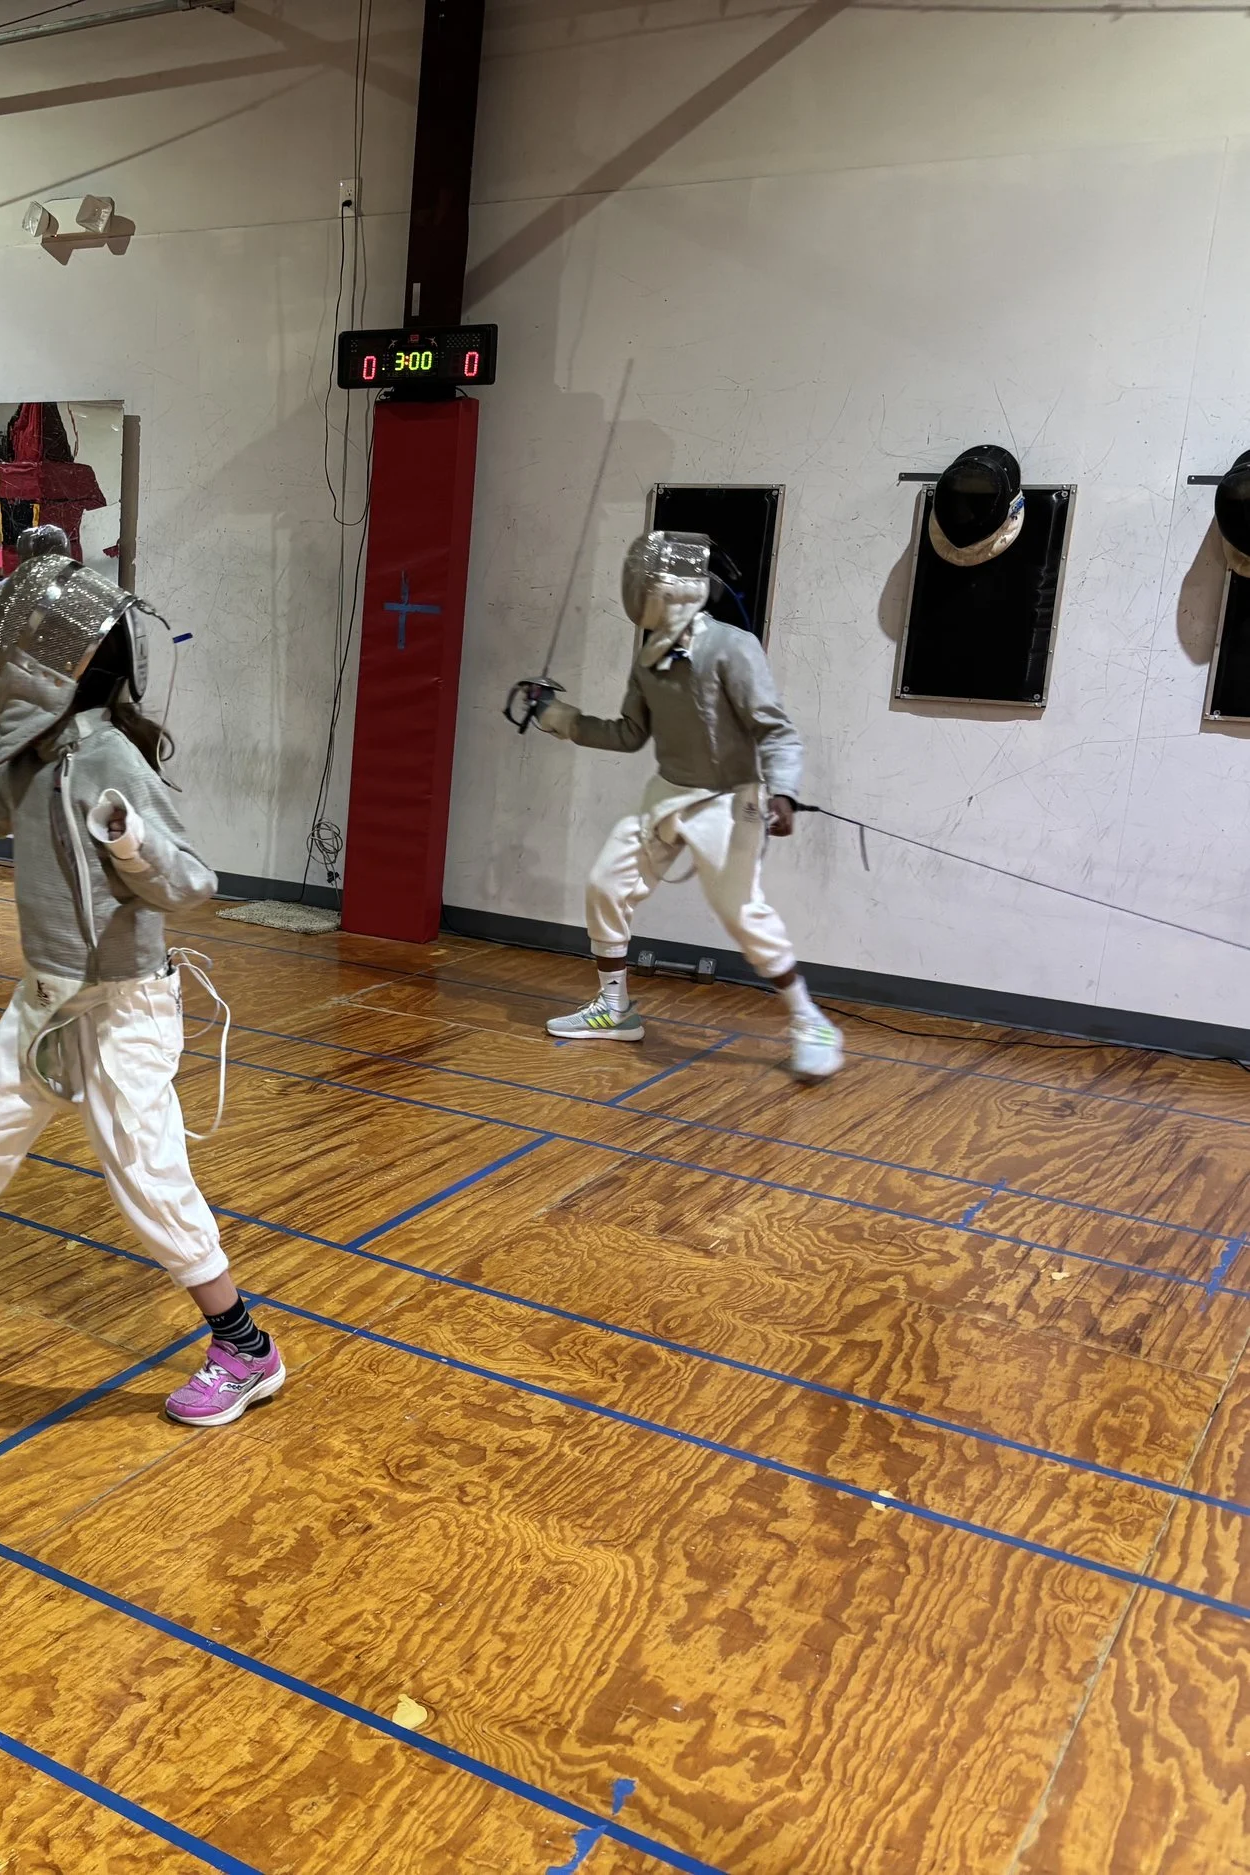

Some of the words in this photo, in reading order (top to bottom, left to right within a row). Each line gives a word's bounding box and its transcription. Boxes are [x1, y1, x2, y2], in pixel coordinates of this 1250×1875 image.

[362, 355, 377, 380] 0
[394, 351, 433, 371] 3:00
[464, 351, 479, 377] 0
